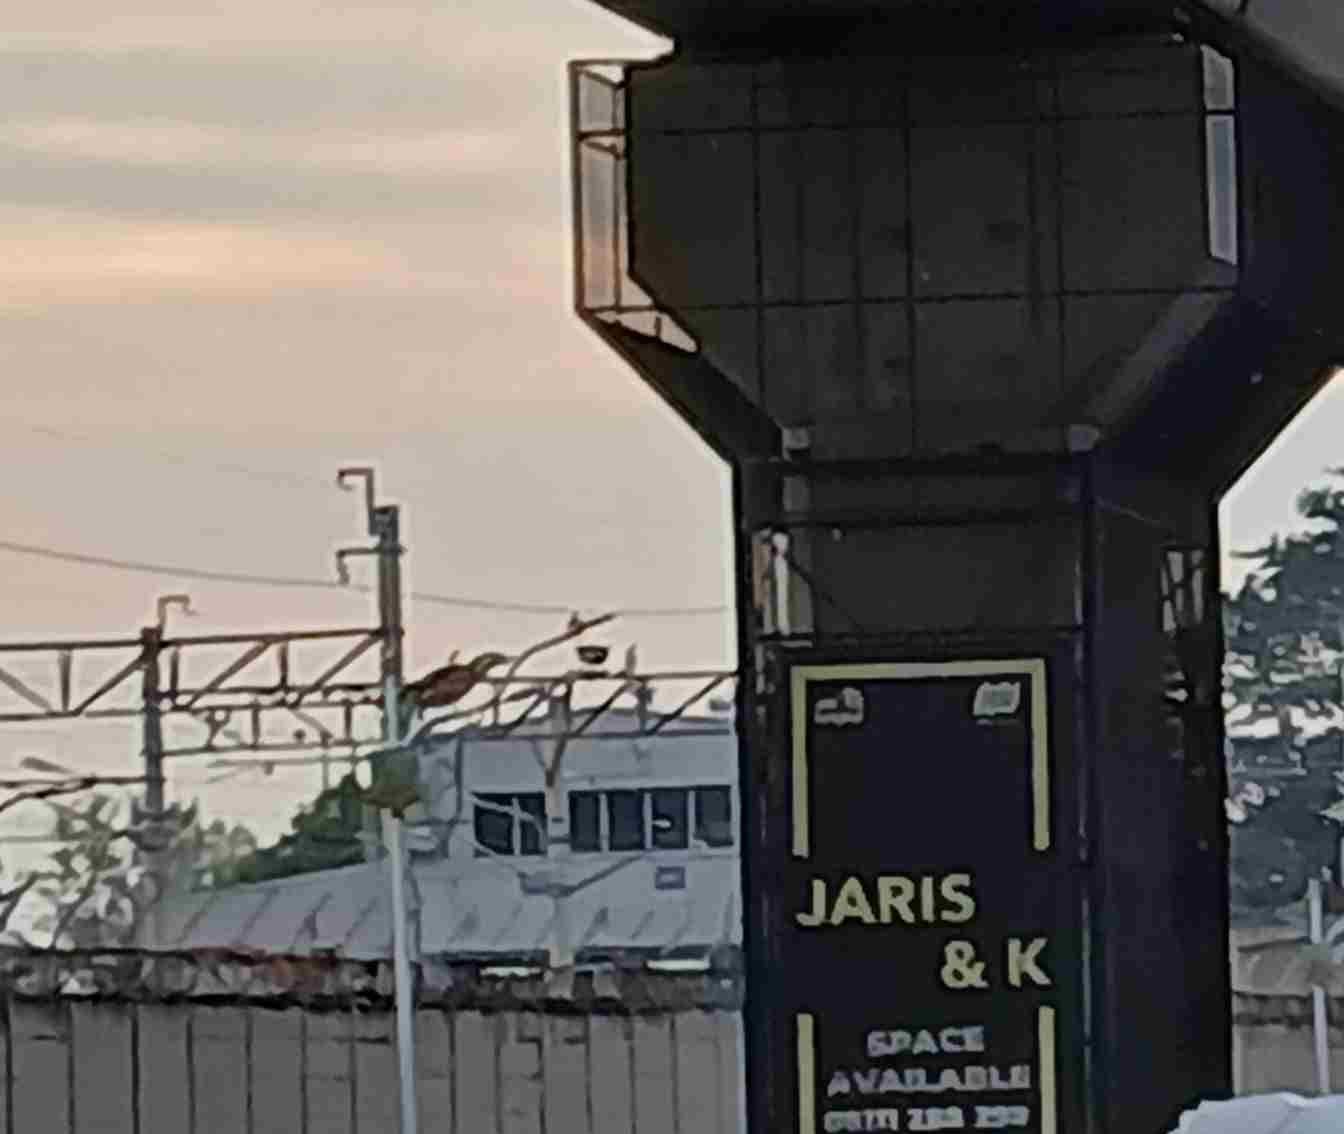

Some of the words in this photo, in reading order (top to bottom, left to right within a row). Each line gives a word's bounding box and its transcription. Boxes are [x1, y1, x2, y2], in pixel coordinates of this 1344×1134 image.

[797, 874, 976, 926] JARIS
[941, 940, 989, 989] &
[1008, 938, 1051, 987] K
[866, 1025, 985, 1057] SPACE
[826, 1064, 1031, 1097] AVAILABLE
